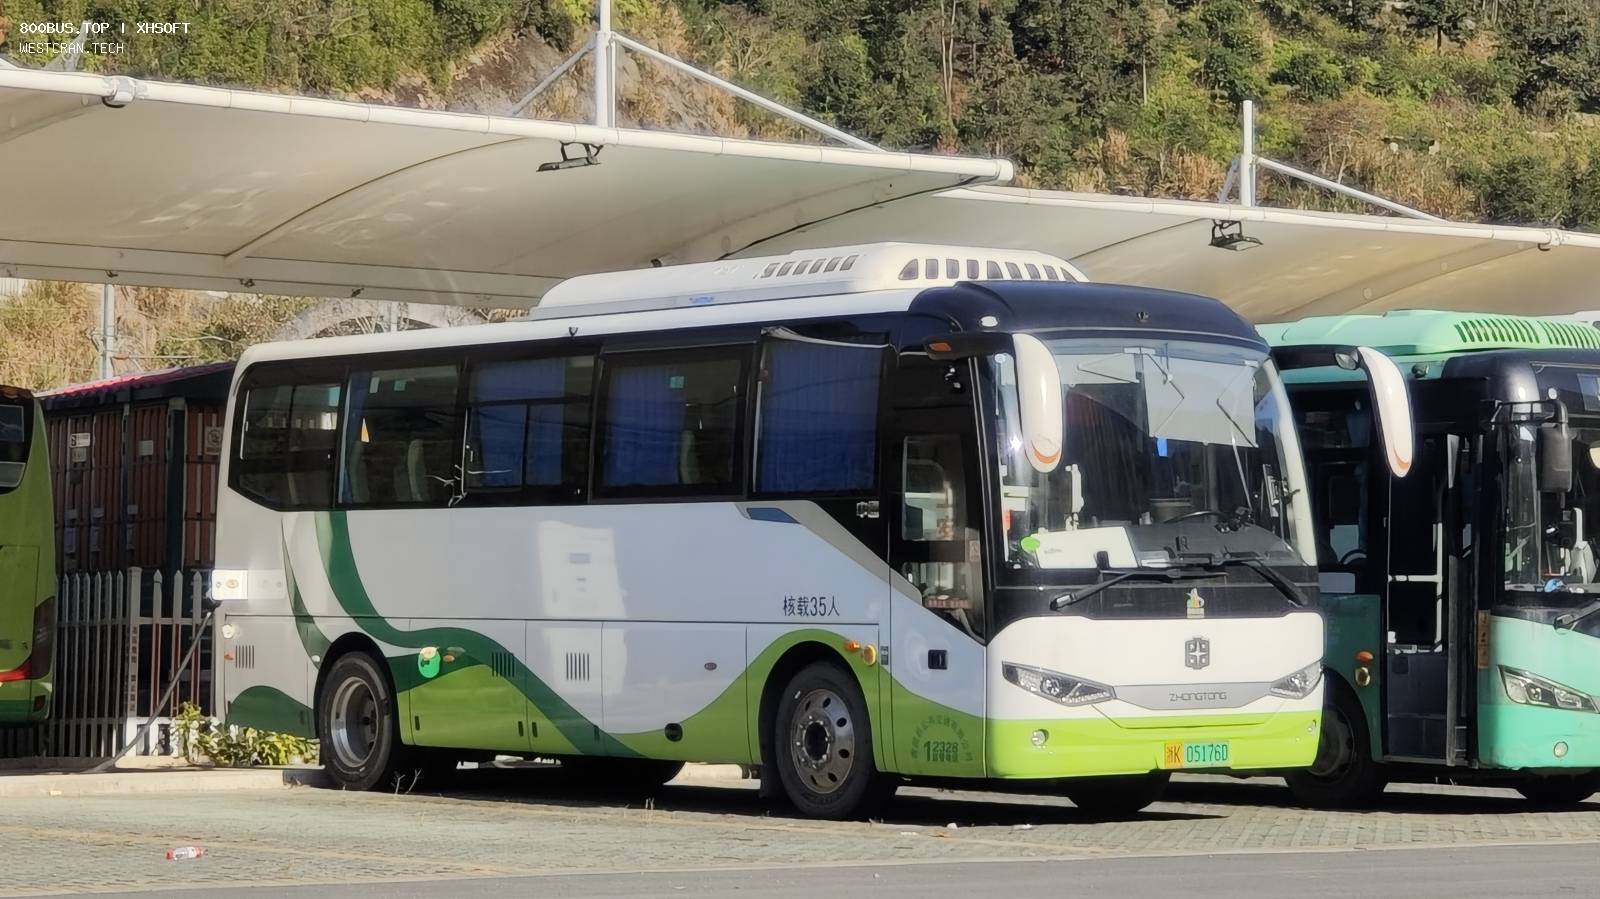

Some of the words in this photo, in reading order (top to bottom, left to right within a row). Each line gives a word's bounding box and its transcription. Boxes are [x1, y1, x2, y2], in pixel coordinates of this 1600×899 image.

[783, 595, 840, 617] 核载35人
[1169, 691, 1227, 702] ZHONGTONG
